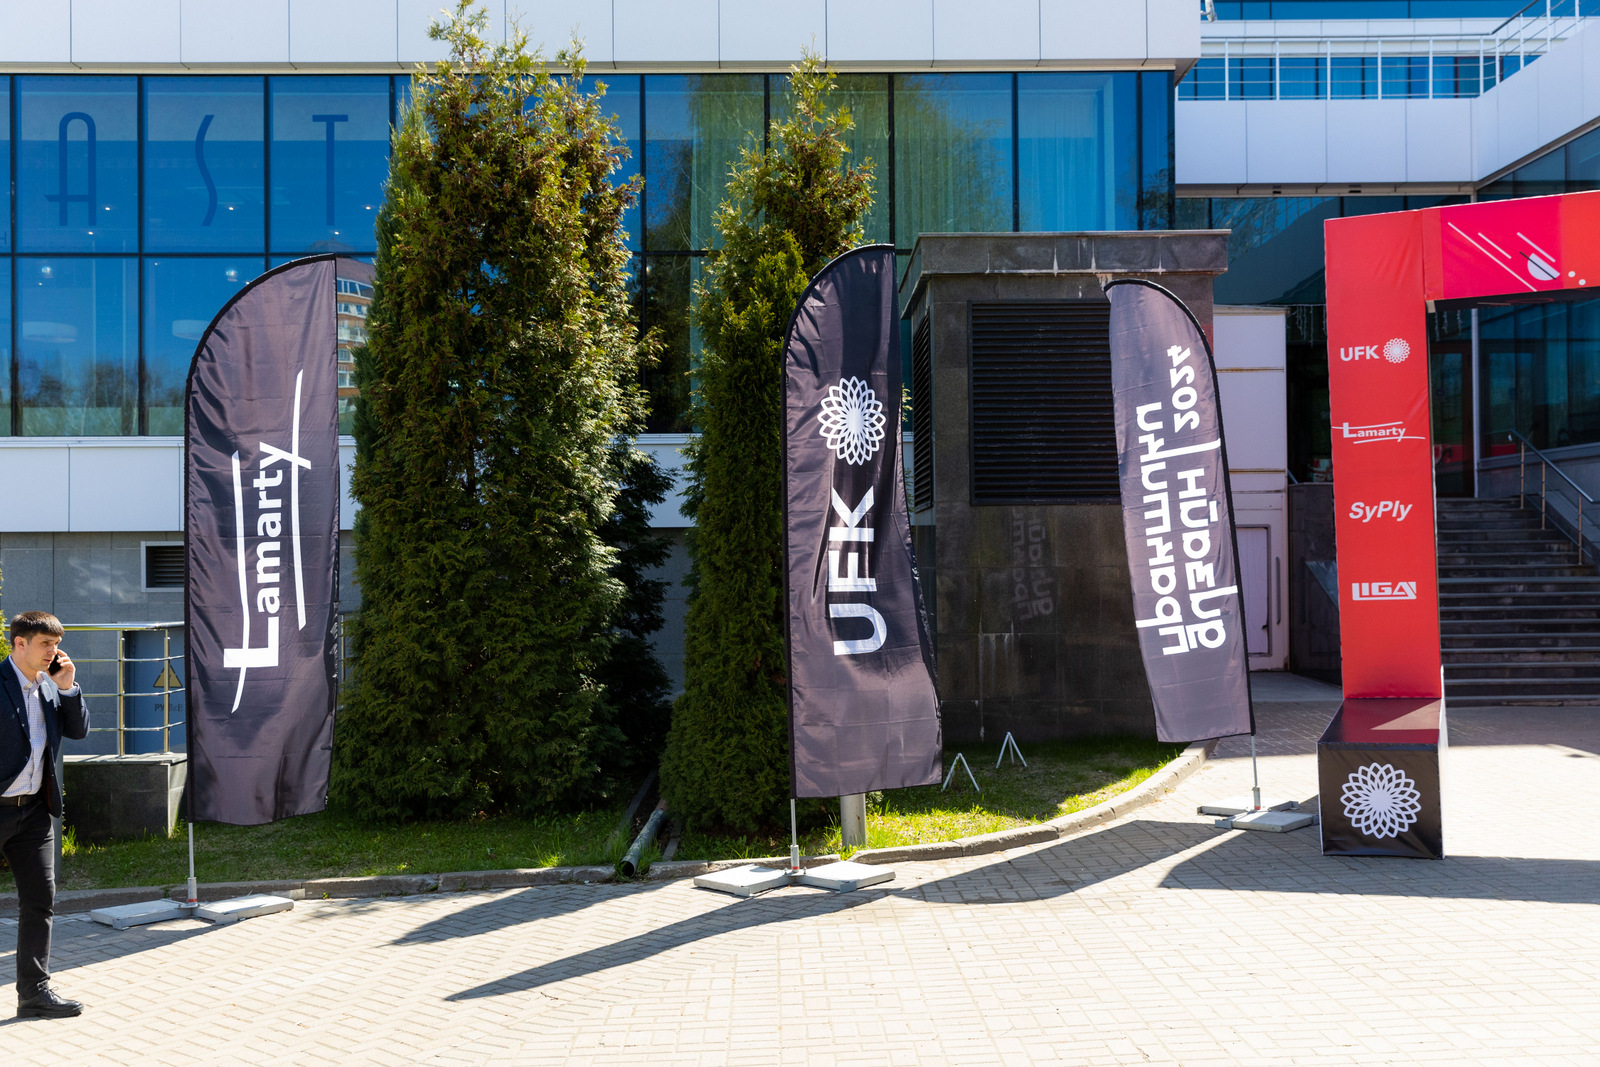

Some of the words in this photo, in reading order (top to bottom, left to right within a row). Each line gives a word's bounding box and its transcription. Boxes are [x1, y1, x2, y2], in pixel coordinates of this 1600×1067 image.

[1340, 344, 1380, 362] UFK
[1341, 421, 1407, 442] Lamarty
[1348, 500, 1413, 523] SyPly
[224, 441, 312, 668] Lamarty
[828, 485, 888, 656] UFK
[1352, 581, 1417, 601] LIGA
